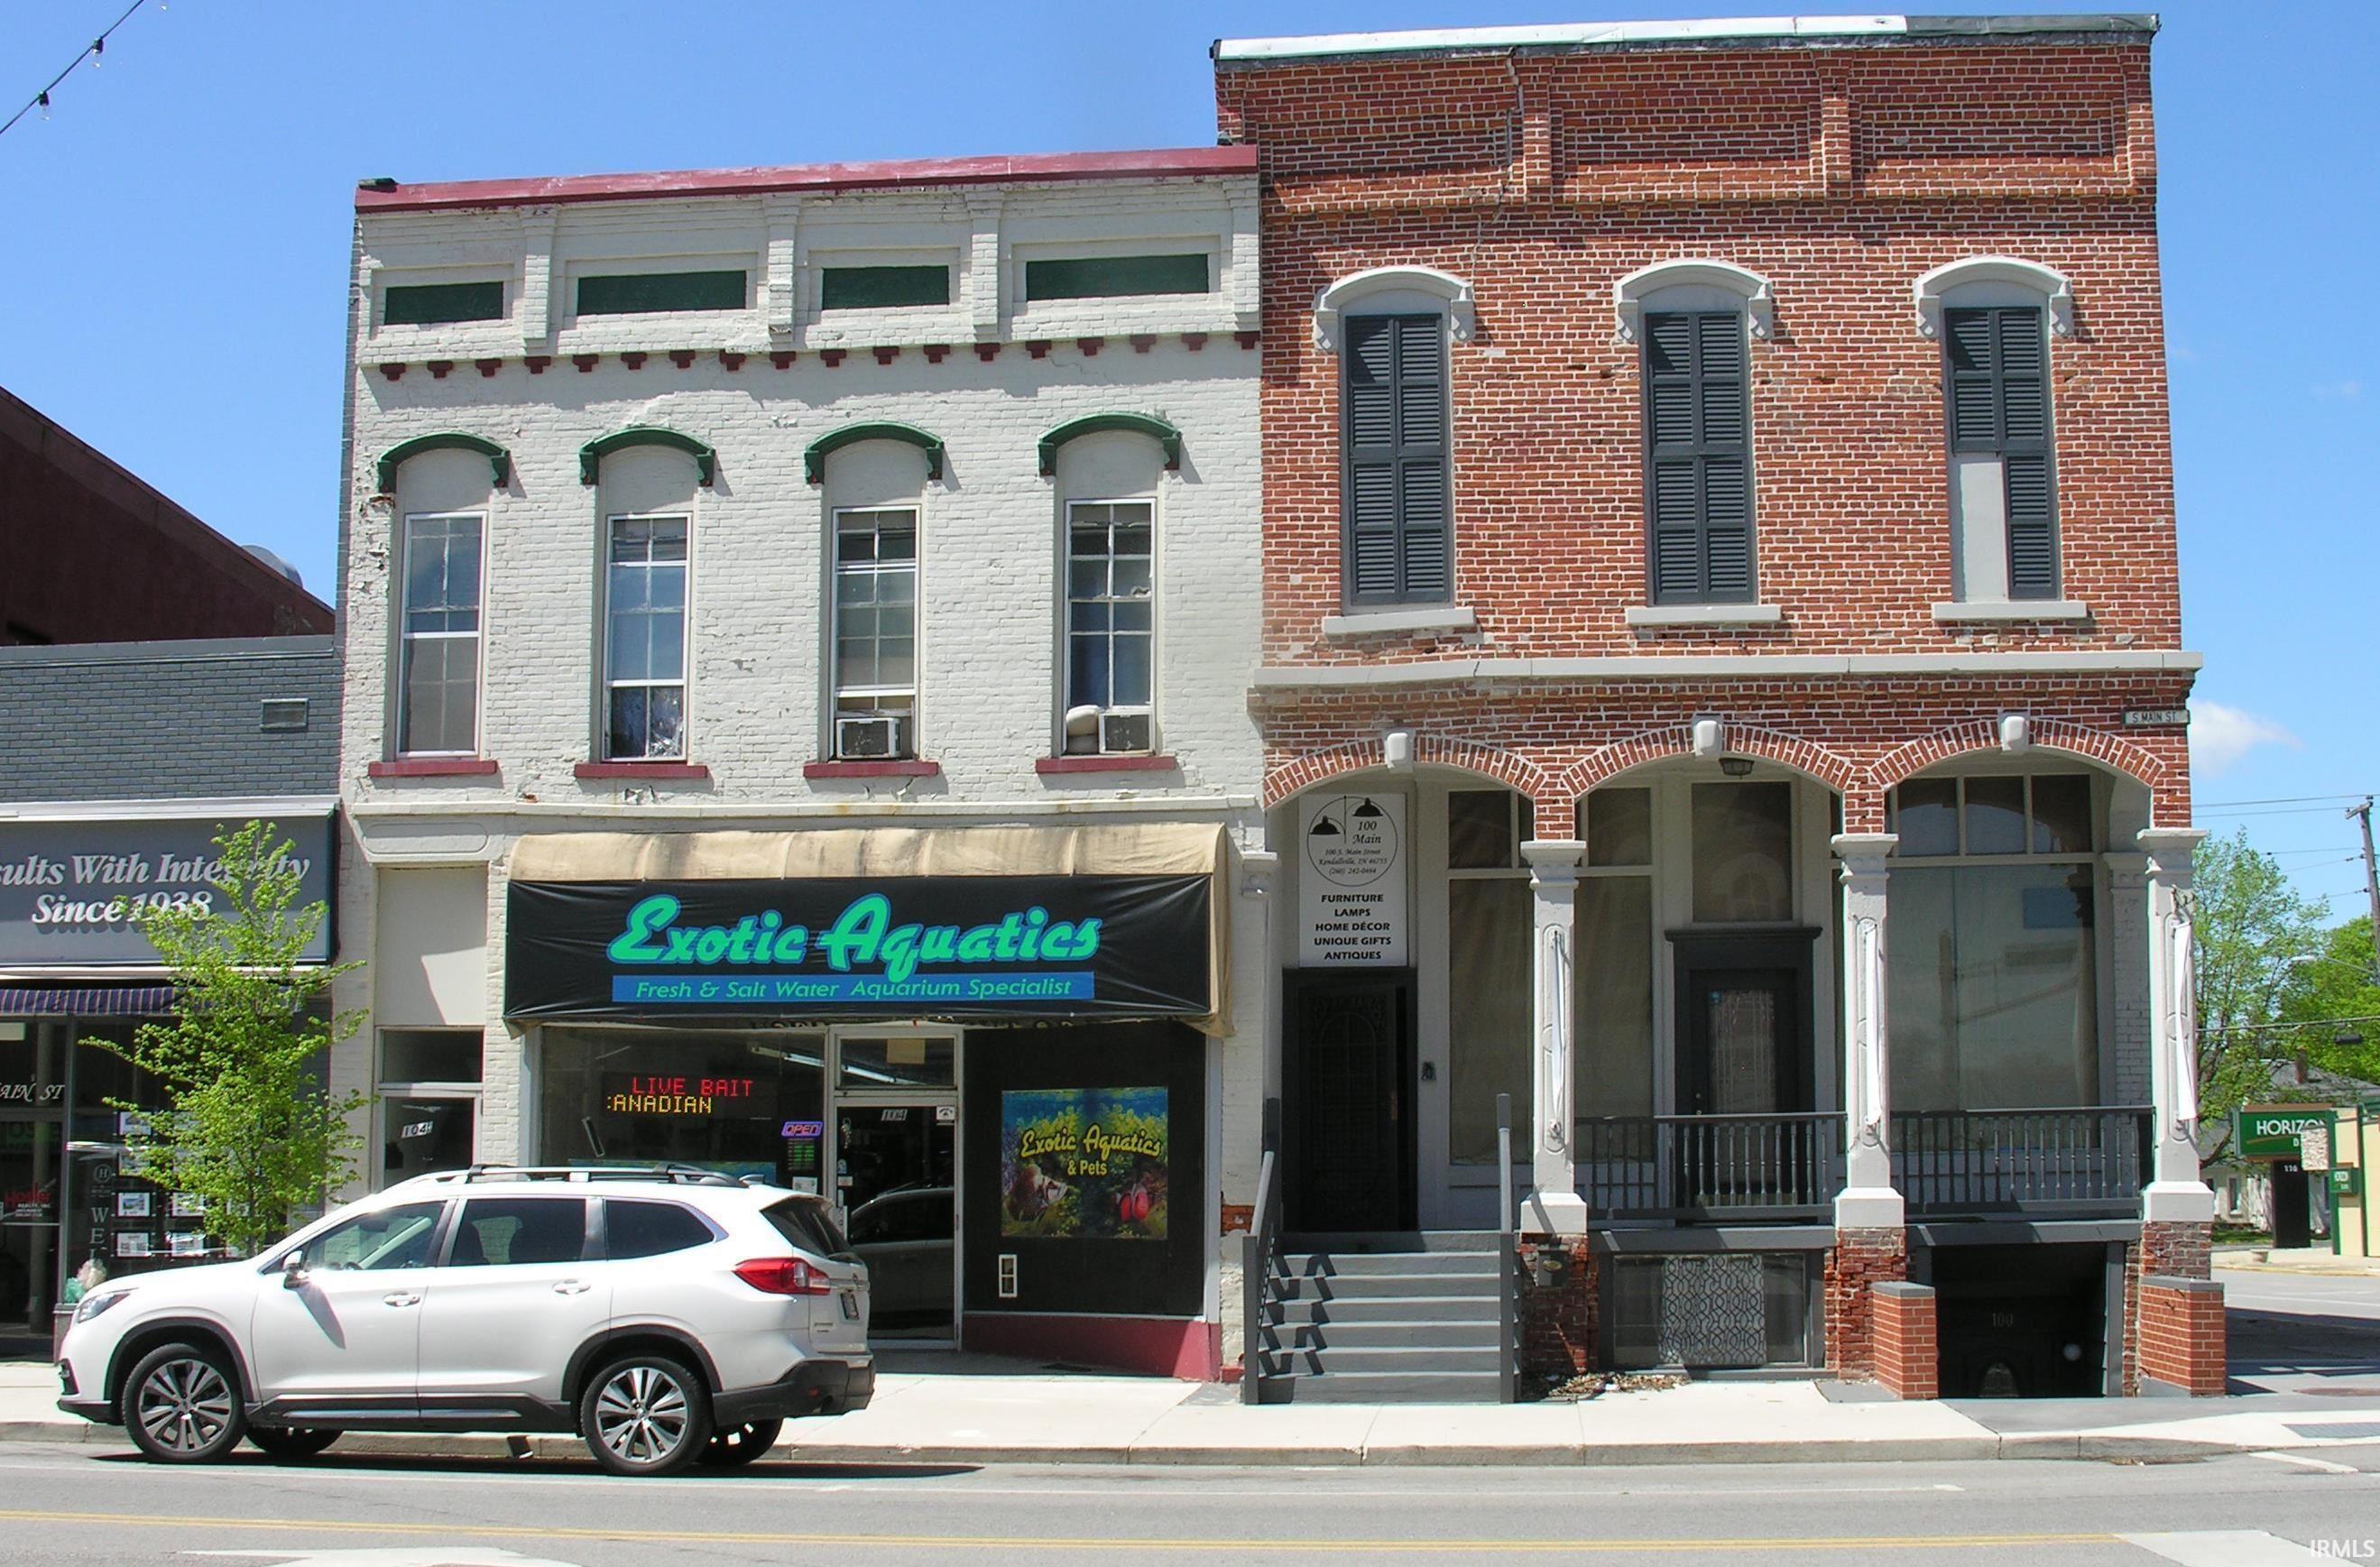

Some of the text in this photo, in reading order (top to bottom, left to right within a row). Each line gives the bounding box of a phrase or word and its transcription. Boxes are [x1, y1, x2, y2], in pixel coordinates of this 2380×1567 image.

[2132, 711, 2176, 723] S MAIN ST
[1358, 821, 1378, 831] 100
[1352, 833, 1382, 844] Main
[0, 854, 66, 885] ults
[72, 853, 150, 884] With
[1321, 894, 1384, 903] FURNITURE
[32, 894, 123, 924] Since
[1334, 908, 1371, 917] LAMPS
[1315, 923, 1349, 931] HOME
[607, 893, 1102, 982] Exotic Aquatics
[1314, 936, 1391, 946] UNIQUE GIFTS
[1324, 951, 1381, 961] ANTIQUES
[635, 978, 1072, 1000] Fresh & Salt Water Aquarium Specialist
[0, 1083, 65, 1103] AIN ST
[632, 1076, 754, 1098] LIVE BAIT
[785, 1124, 819, 1135] OPEN
[2256, 1119, 2326, 1136] HORIZ
[1020, 1123, 1162, 1158] Exotic Aquatics
[1067, 1158, 1108, 1175] & Pets
